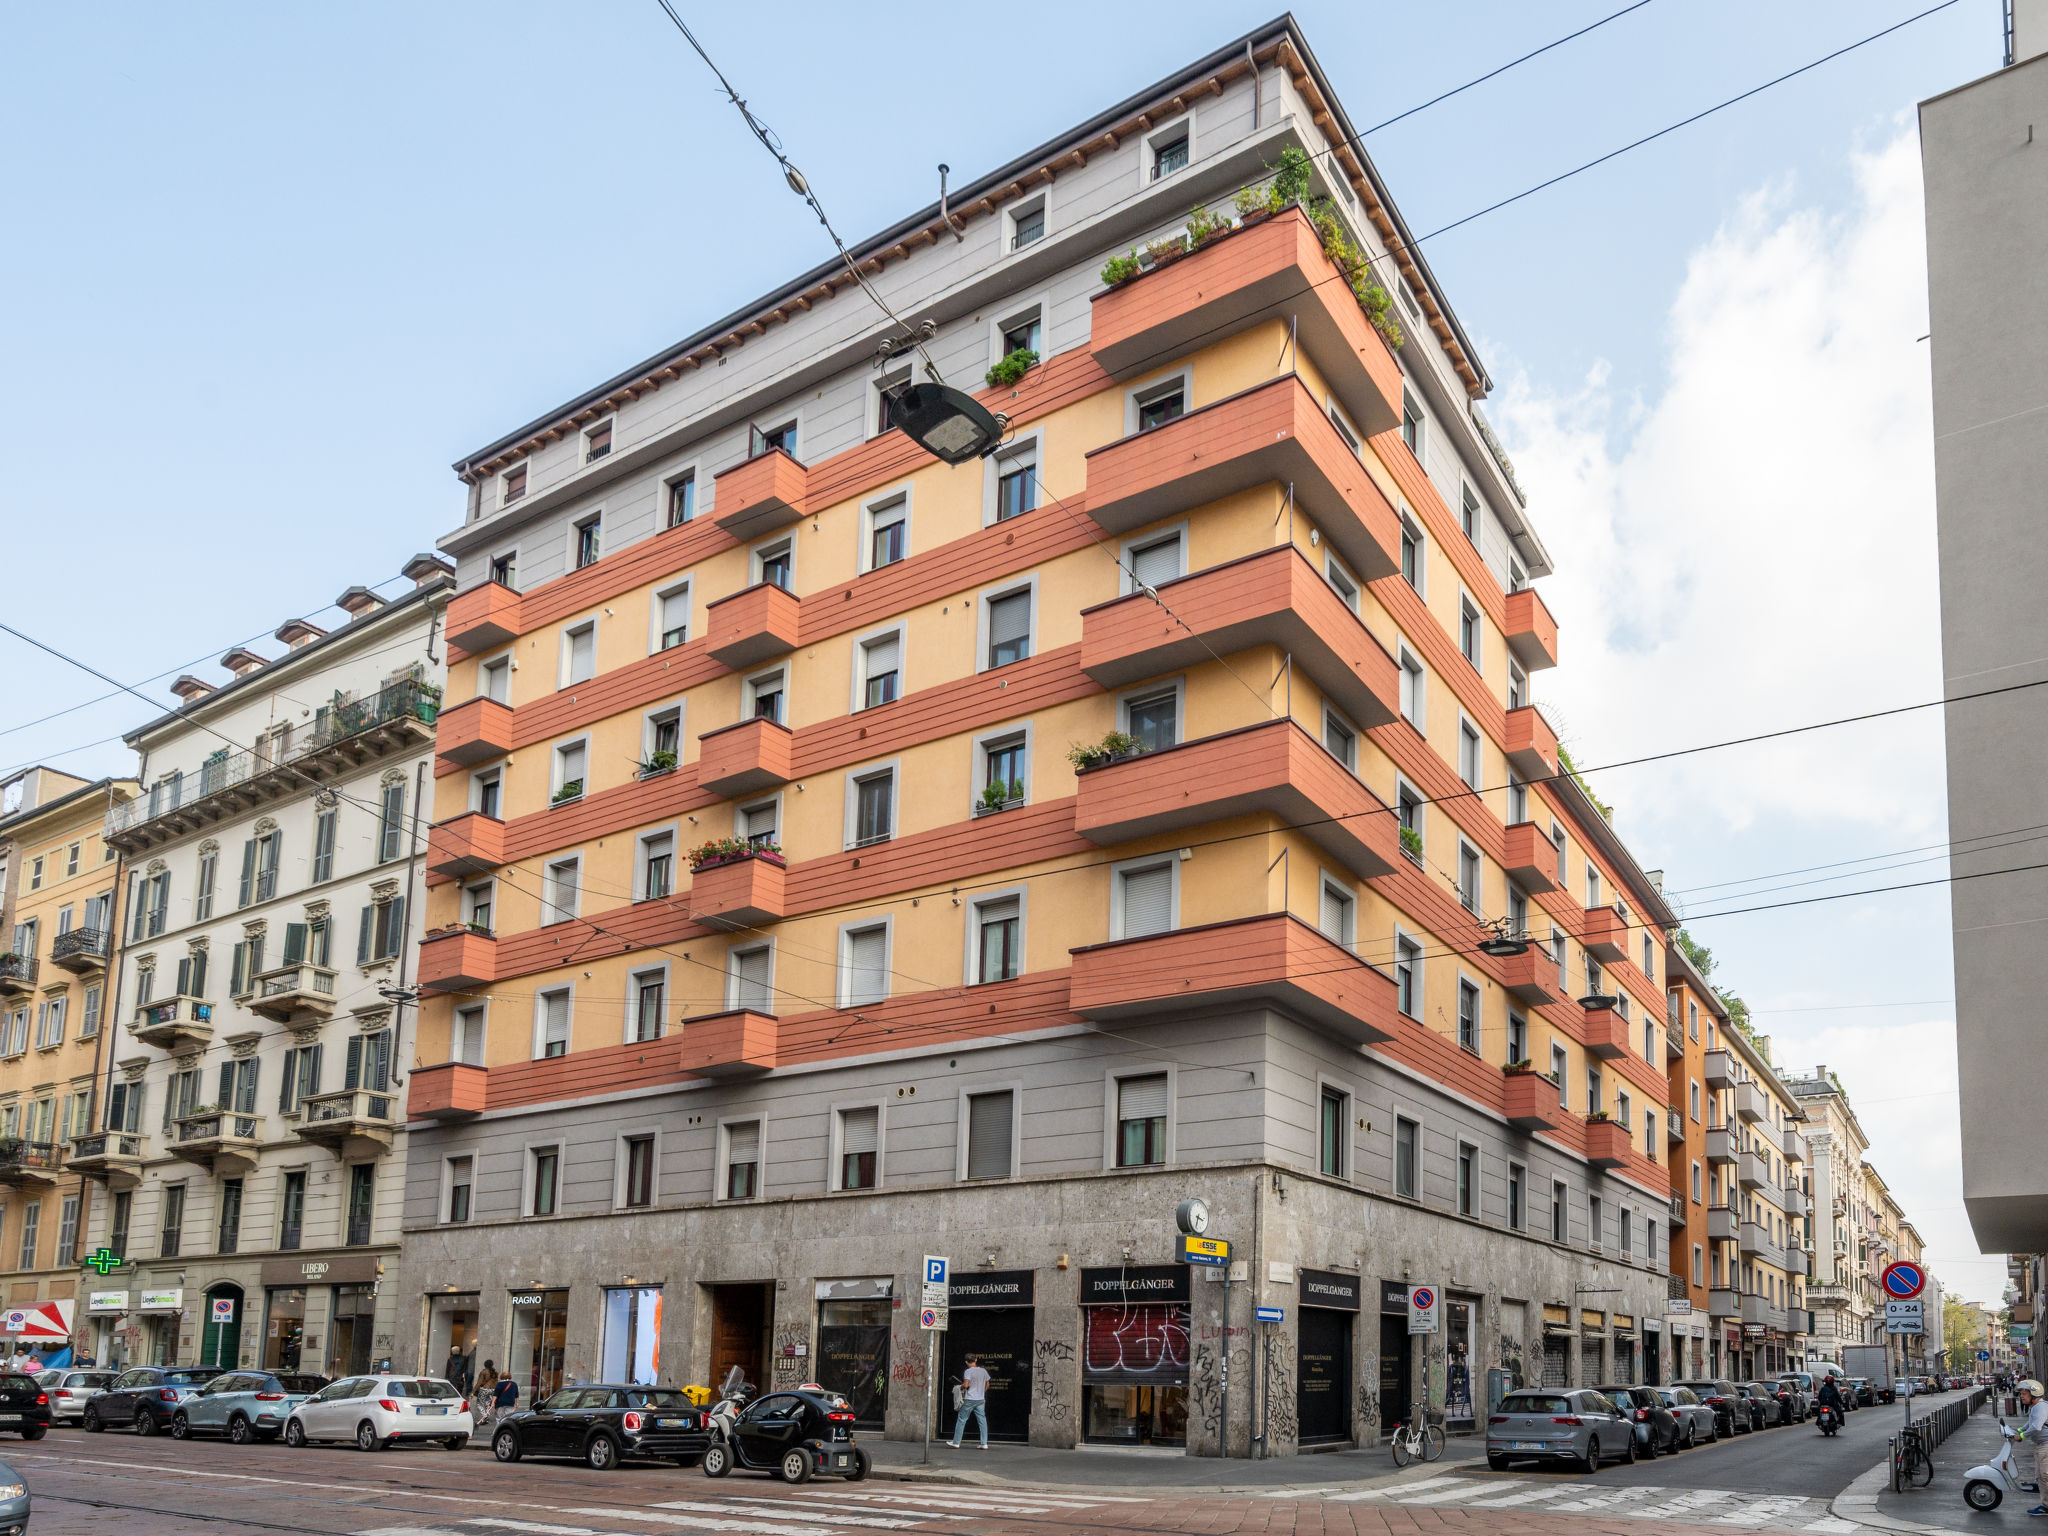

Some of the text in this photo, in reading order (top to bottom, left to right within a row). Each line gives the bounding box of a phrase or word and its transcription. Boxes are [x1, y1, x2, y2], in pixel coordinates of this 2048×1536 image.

[301, 1262, 329, 1274] LIBERO
[930, 1262, 942, 1280] P
[512, 1295, 542, 1304] RAGNO
